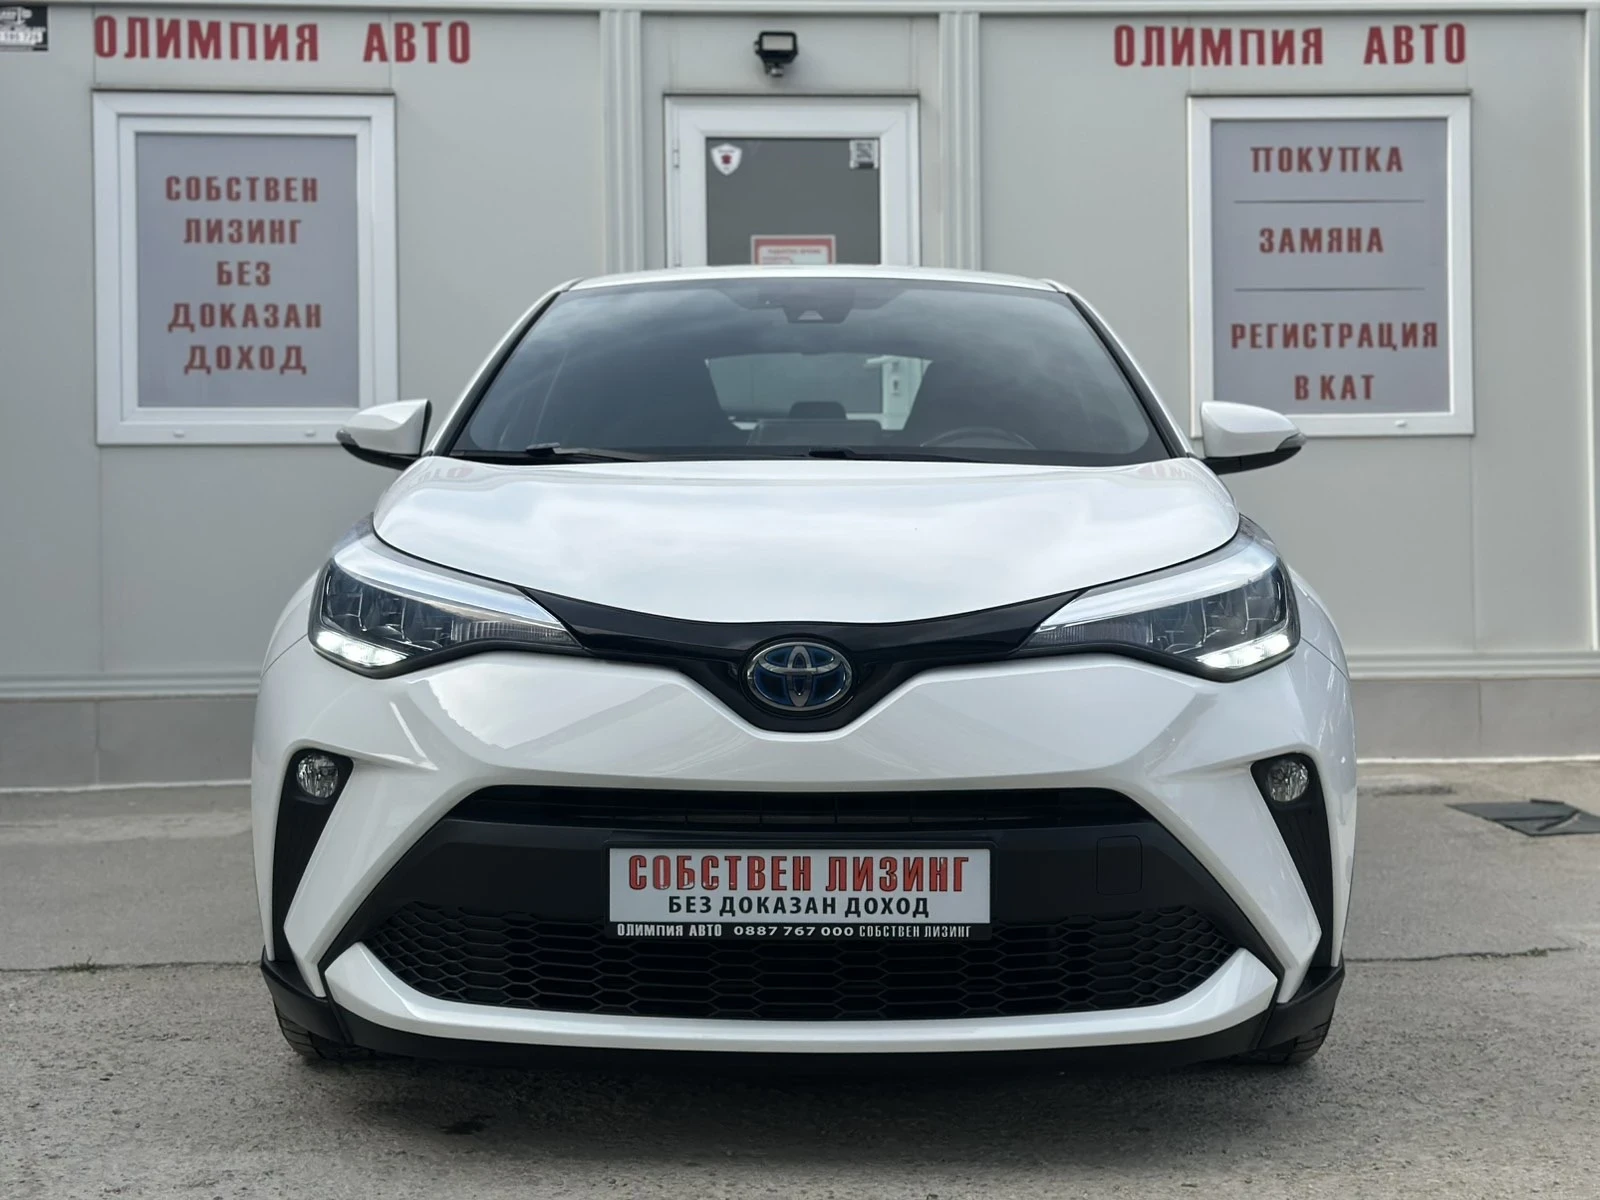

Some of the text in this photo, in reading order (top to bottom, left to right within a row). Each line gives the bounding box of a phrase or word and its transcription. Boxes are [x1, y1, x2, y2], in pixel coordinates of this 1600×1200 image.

[93, 15, 471, 64] ОЛИМПИЯ АВТО
[1114, 22, 1466, 67] ОЛИМПИЯ АВТО
[1250, 147, 1404, 173] ПОКУПКА
[165, 175, 319, 203] СОБСТВЕН
[183, 218, 303, 245] ЛИЗИНГ
[1259, 227, 1384, 254] ЗАМЯНА
[216, 260, 271, 286] БЕЗ
[167, 302, 322, 333] ДОКАЗАН
[1231, 322, 1438, 351] РЕГИСТРАЦИЯ
[183, 345, 308, 375] ДОХОД
[1294, 374, 1375, 401] В КАТ
[628, 854, 970, 892] СОБСТВЕН ЛИЗИНГ
[668, 895, 930, 918] БЕЗ ДОКАЗАН ДОХОД
[617, 923, 971, 938] ОЛИМПИЯ АВТО 0887 767 000 СОБСТВЕН ЛИЗИНГ
